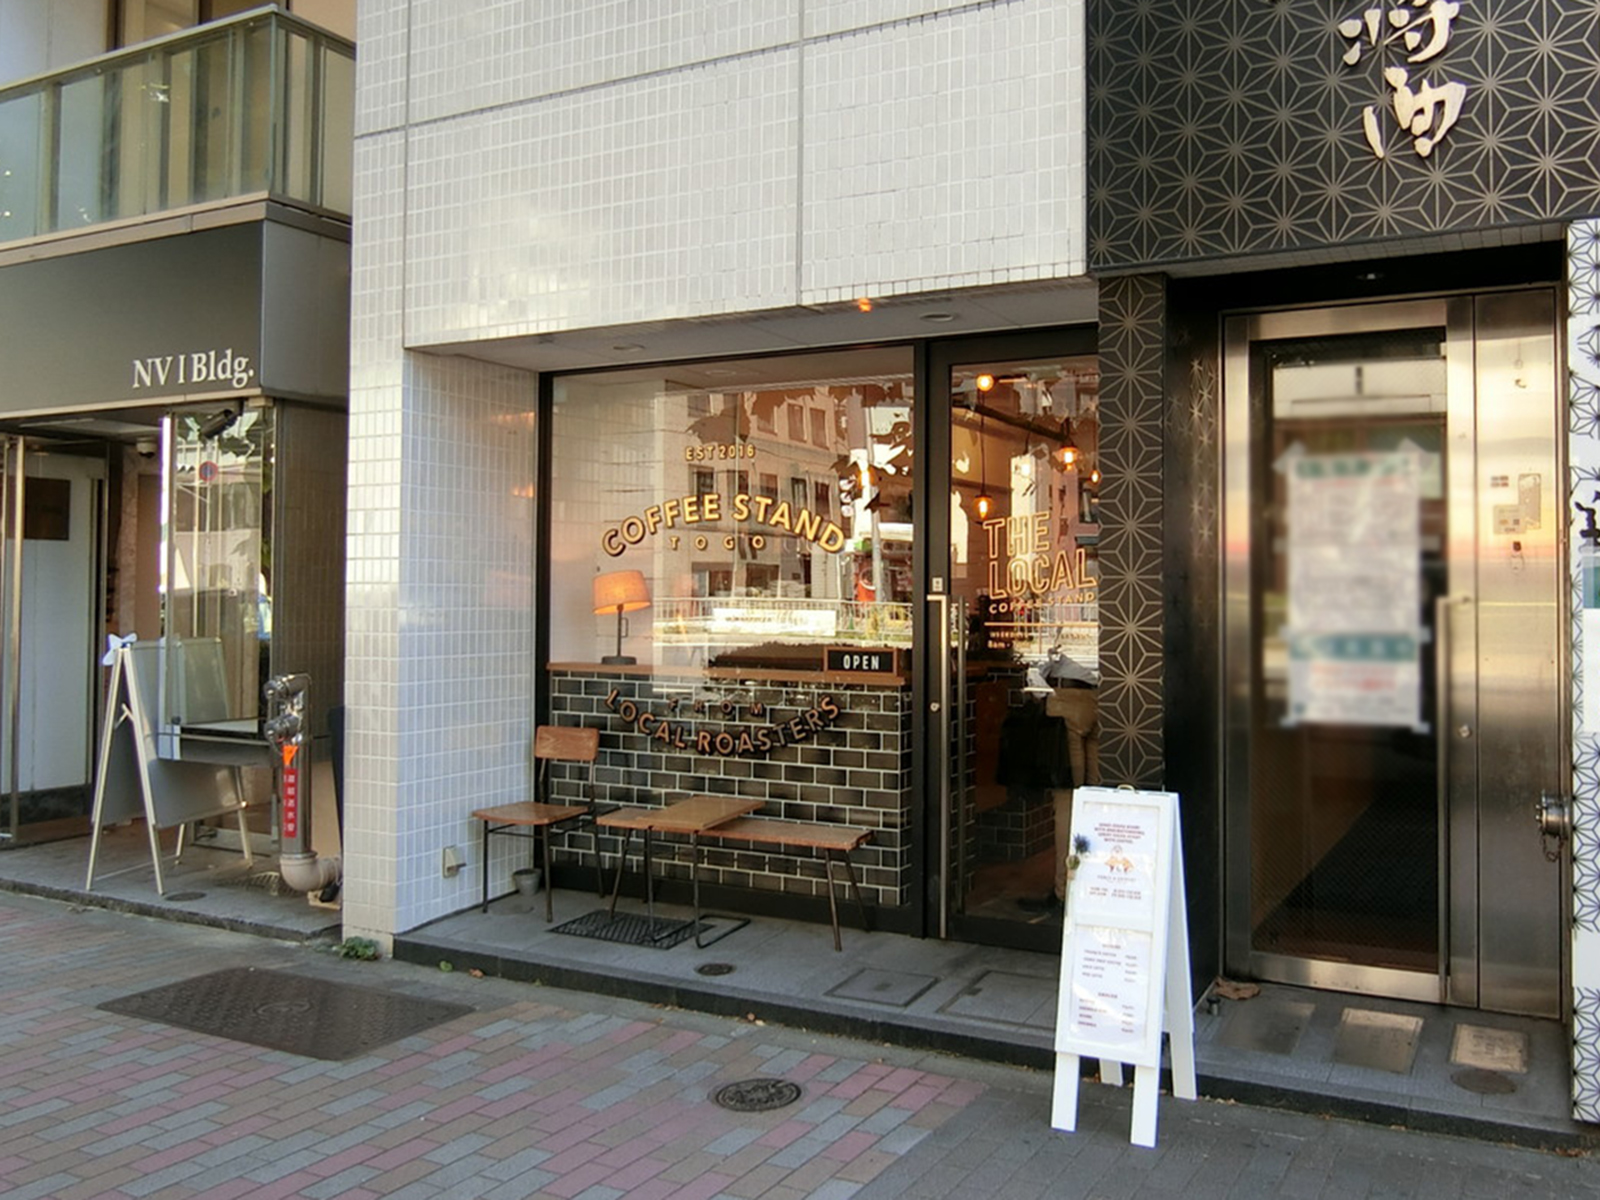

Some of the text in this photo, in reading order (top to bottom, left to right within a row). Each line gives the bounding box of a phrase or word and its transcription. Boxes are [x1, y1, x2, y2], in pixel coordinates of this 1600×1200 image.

[132, 348, 254, 388] NV I Bldg.
[602, 493, 845, 557] COFFEE STAND
[982, 511, 1050, 559] THE
[989, 548, 1098, 599] LOCAL
[842, 654, 880, 670] OPEN
[605, 688, 840, 754] LOCAL ROASTERS
